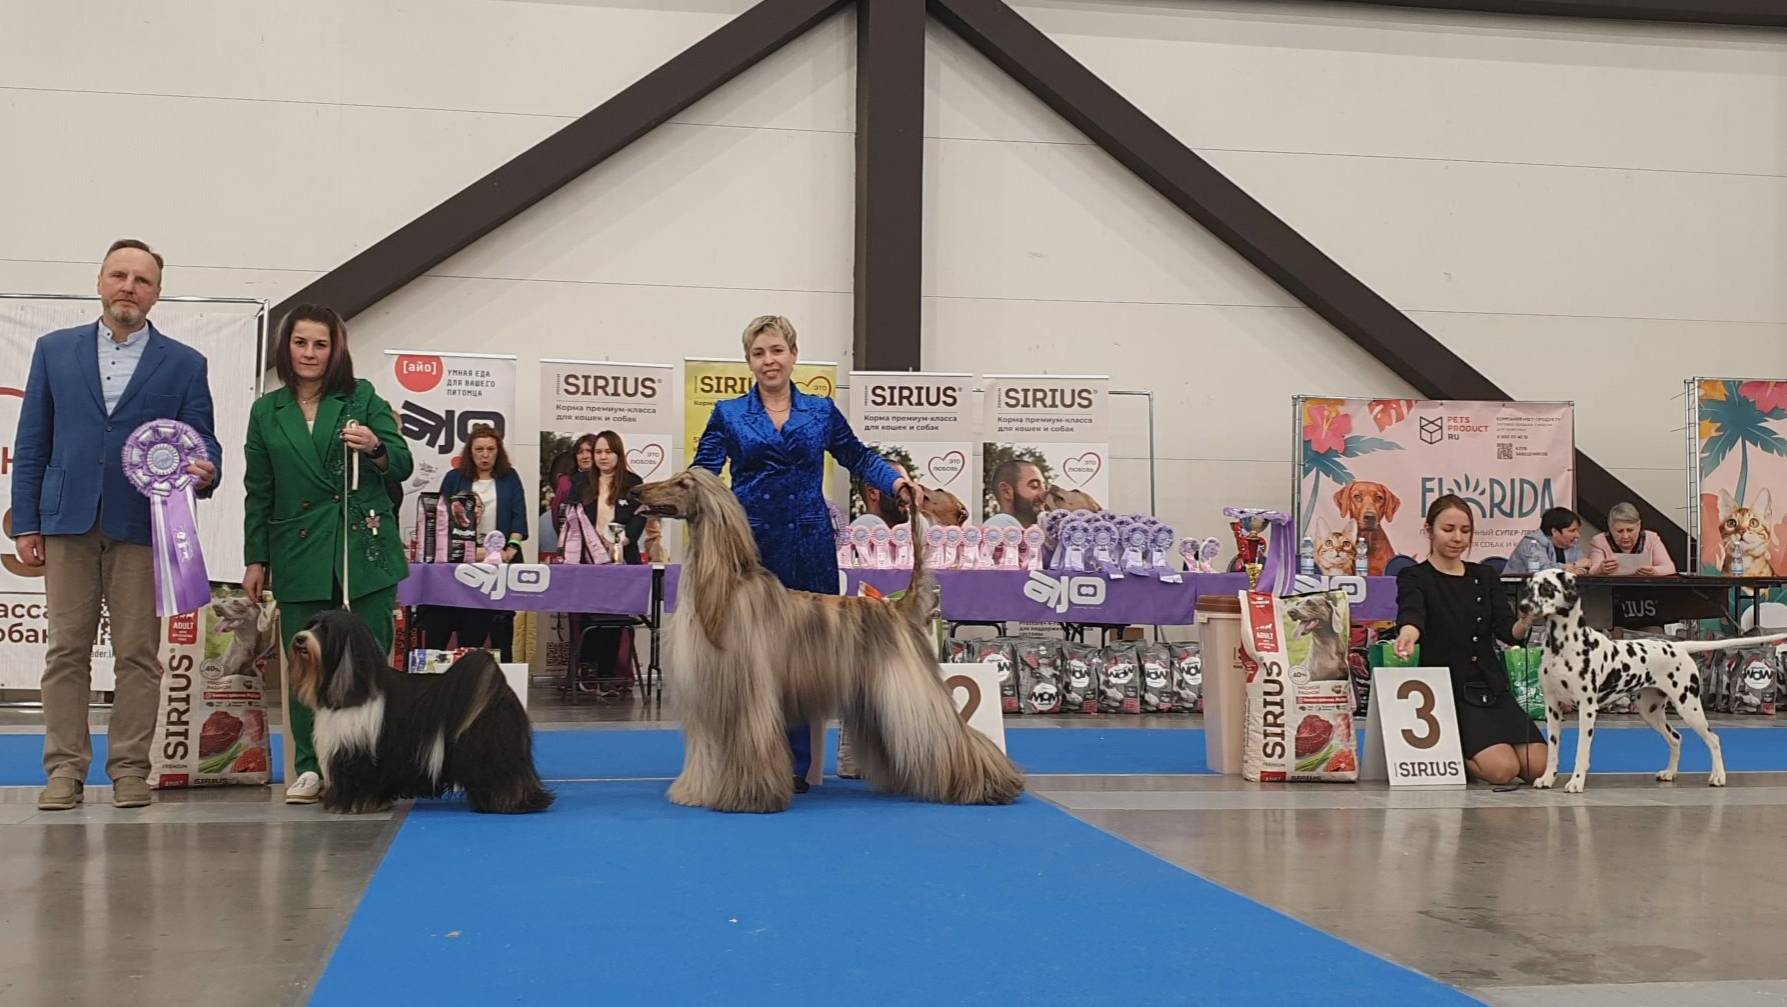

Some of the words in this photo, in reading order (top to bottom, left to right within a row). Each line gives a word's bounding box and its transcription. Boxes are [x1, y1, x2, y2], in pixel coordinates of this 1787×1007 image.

[475, 370, 491, 378] ЕДА
[447, 379, 463, 387] ДЛЯ
[563, 373, 657, 398] SIRIUS
[700, 376, 752, 394] SIRI
[447, 389, 482, 397] ПИТОМЦА
[871, 385, 958, 407] SIRIUS
[1004, 387, 1093, 409] SIRIUS
[586, 405, 657, 414] премиум-класса
[864, 415, 890, 423] Корма
[1448, 416, 1470, 424] PETS
[1448, 425, 1489, 433] PRODUCT
[173, 622, 194, 630] ADULT
[163, 654, 194, 760] SIRIUS
[1262, 661, 1285, 760] SIRIUS
[1397, 679, 1441, 749] 3
[1399, 761, 1459, 777] SIRIUS
